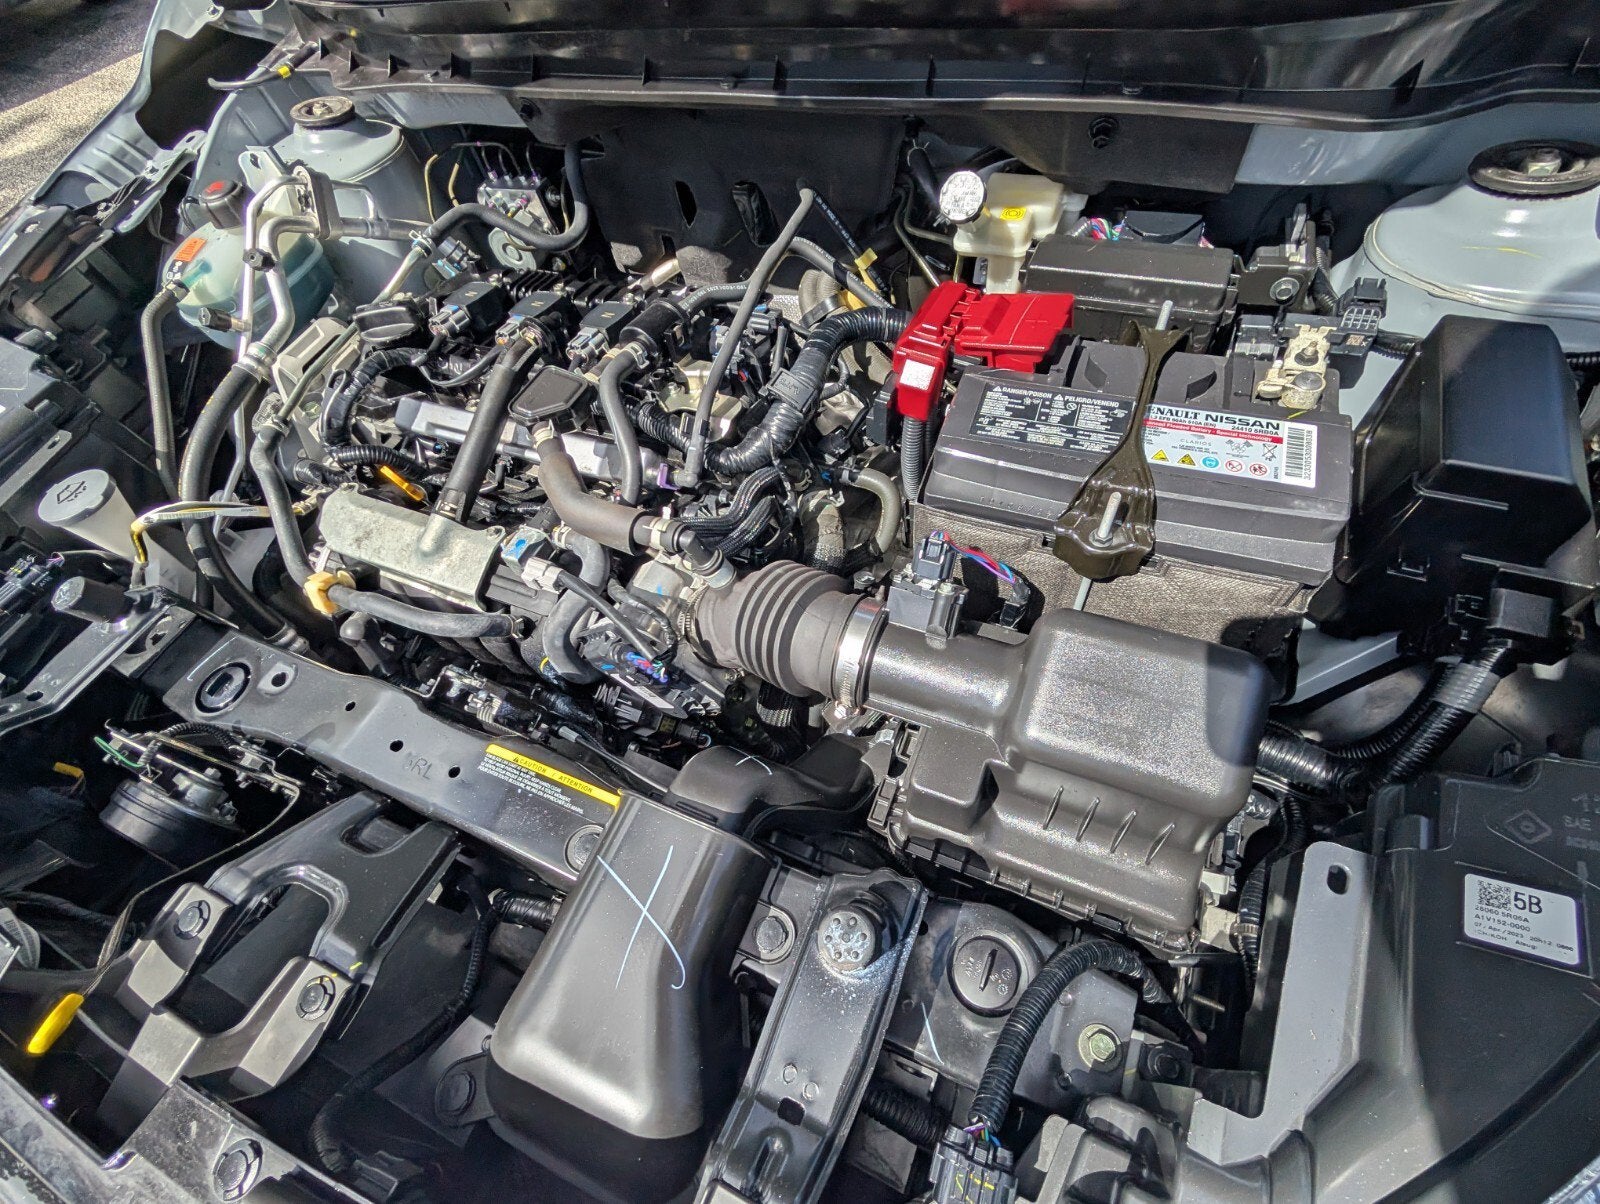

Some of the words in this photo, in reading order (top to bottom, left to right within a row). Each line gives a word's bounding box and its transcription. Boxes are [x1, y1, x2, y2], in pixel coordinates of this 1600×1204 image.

[1002, 387, 1053, 399] DANGER/POISON
[1064, 395, 1120, 408] PELIGRO/VENENO
[1149, 406, 1201, 421] ENAULT
[1204, 414, 1280, 431] NISSAN
[1215, 429, 1239, 438] Special
[1180, 438, 1213, 447] CLARIOS
[518, 757, 547, 774] CAUTION
[557, 774, 593, 793] ATTENTION
[1514, 891, 1542, 914] 5B
